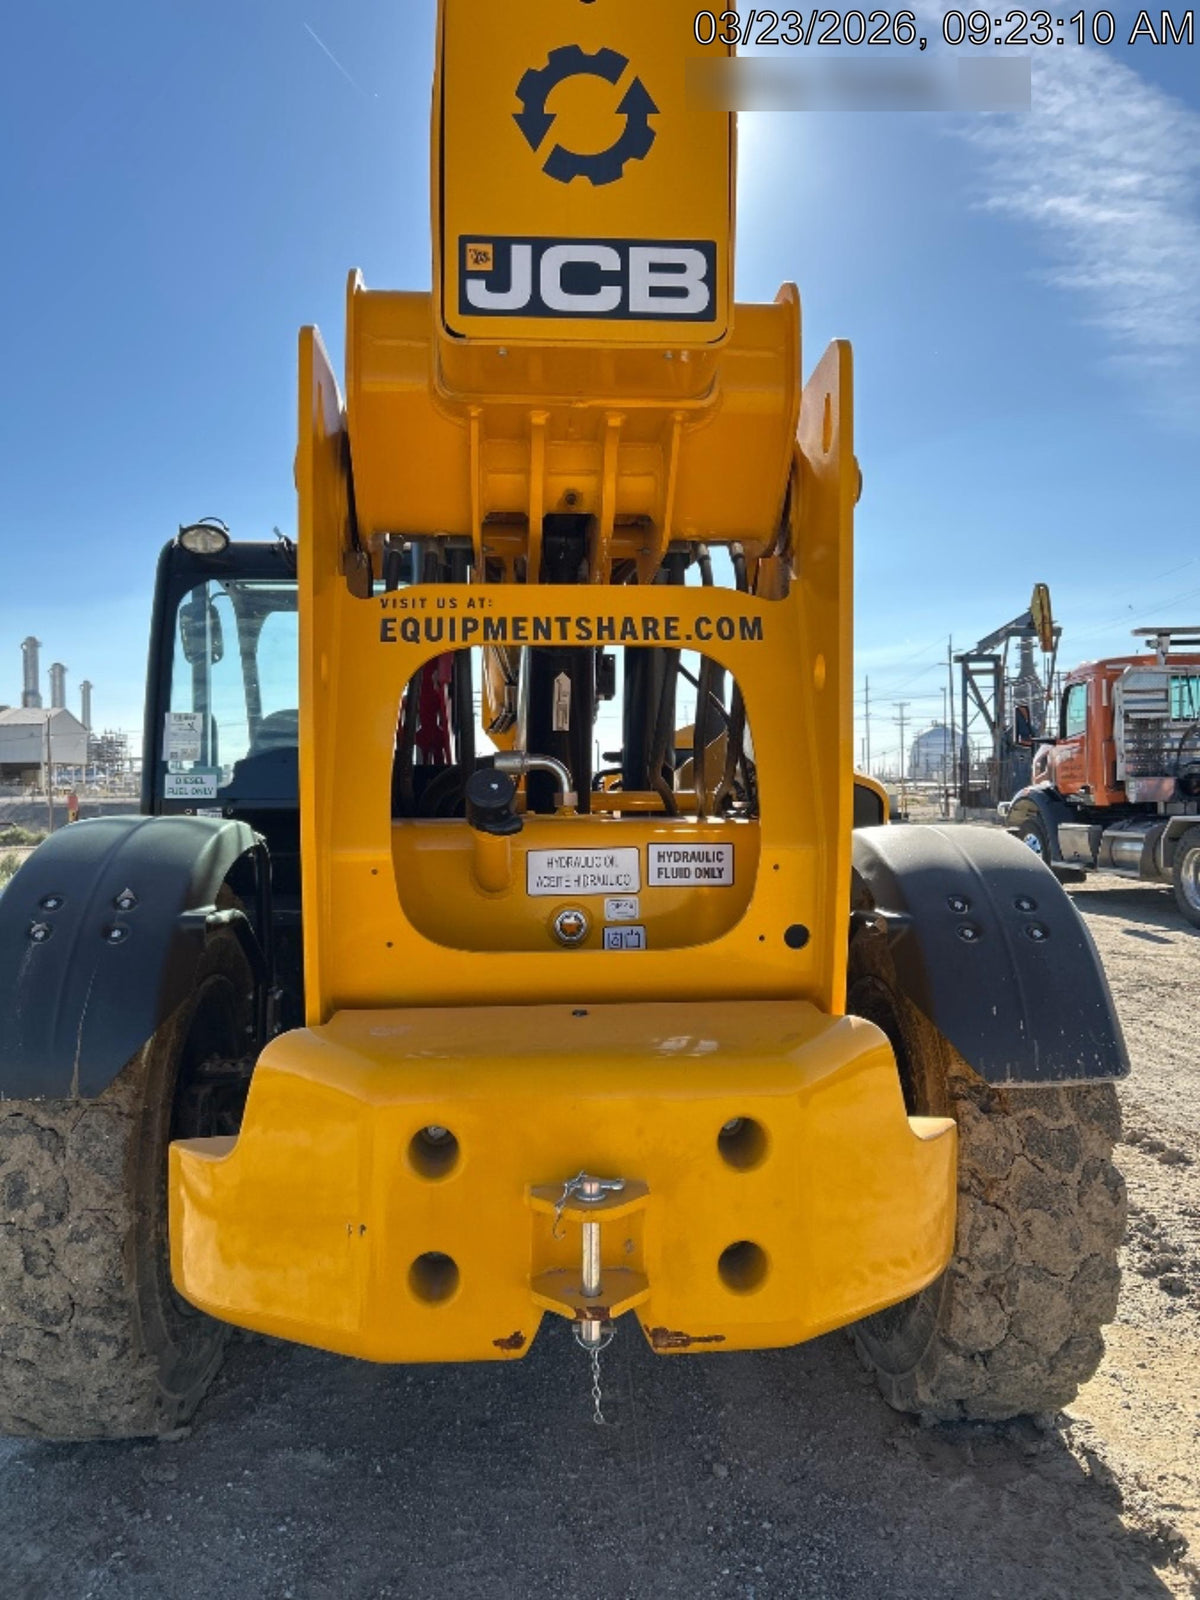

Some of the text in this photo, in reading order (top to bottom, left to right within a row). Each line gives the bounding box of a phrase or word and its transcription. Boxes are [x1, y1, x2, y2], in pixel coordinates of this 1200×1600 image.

[466, 244, 710, 314] JCB
[380, 598, 493, 609] VISIT US AT:
[380, 616, 763, 644] EQUIPMENTSHARE.COM
[657, 851, 724, 863] HYDRAULIC
[657, 867, 724, 879] FLUID ONLY
